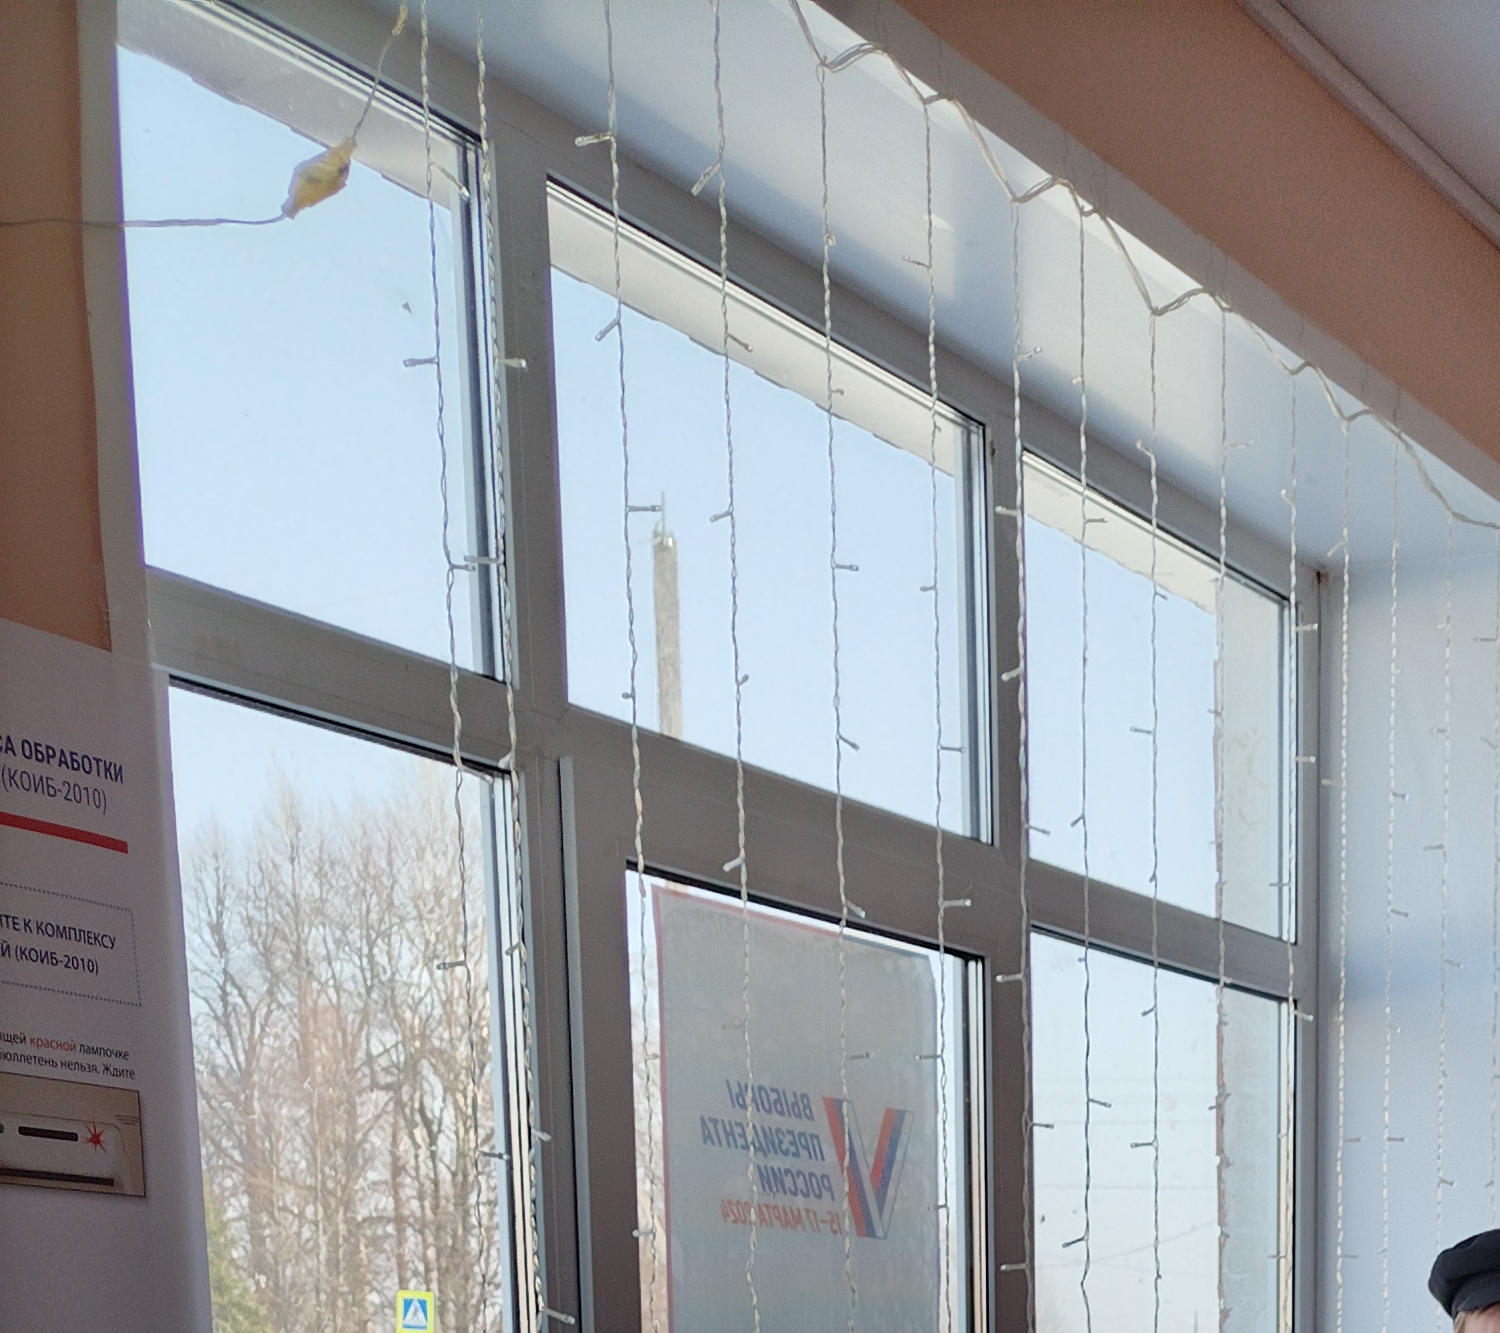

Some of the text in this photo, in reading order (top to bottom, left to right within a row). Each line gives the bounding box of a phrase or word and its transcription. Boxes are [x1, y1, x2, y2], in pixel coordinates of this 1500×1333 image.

[0, 734, 124, 785] А ОБРАБОТКИ
[1, 764, 107, 815] (КОИБ-2010)
[23, 917, 34, 934] К
[36, 920, 116, 950] КОМПЛЕКСУ
[15, 944, 99, 976] (КОИБ-2010)
[30, 1036, 77, 1053] красной
[79, 1042, 130, 1062] лампочке
[0, 1050, 136, 1081] юллетень нельзя. Ждите
